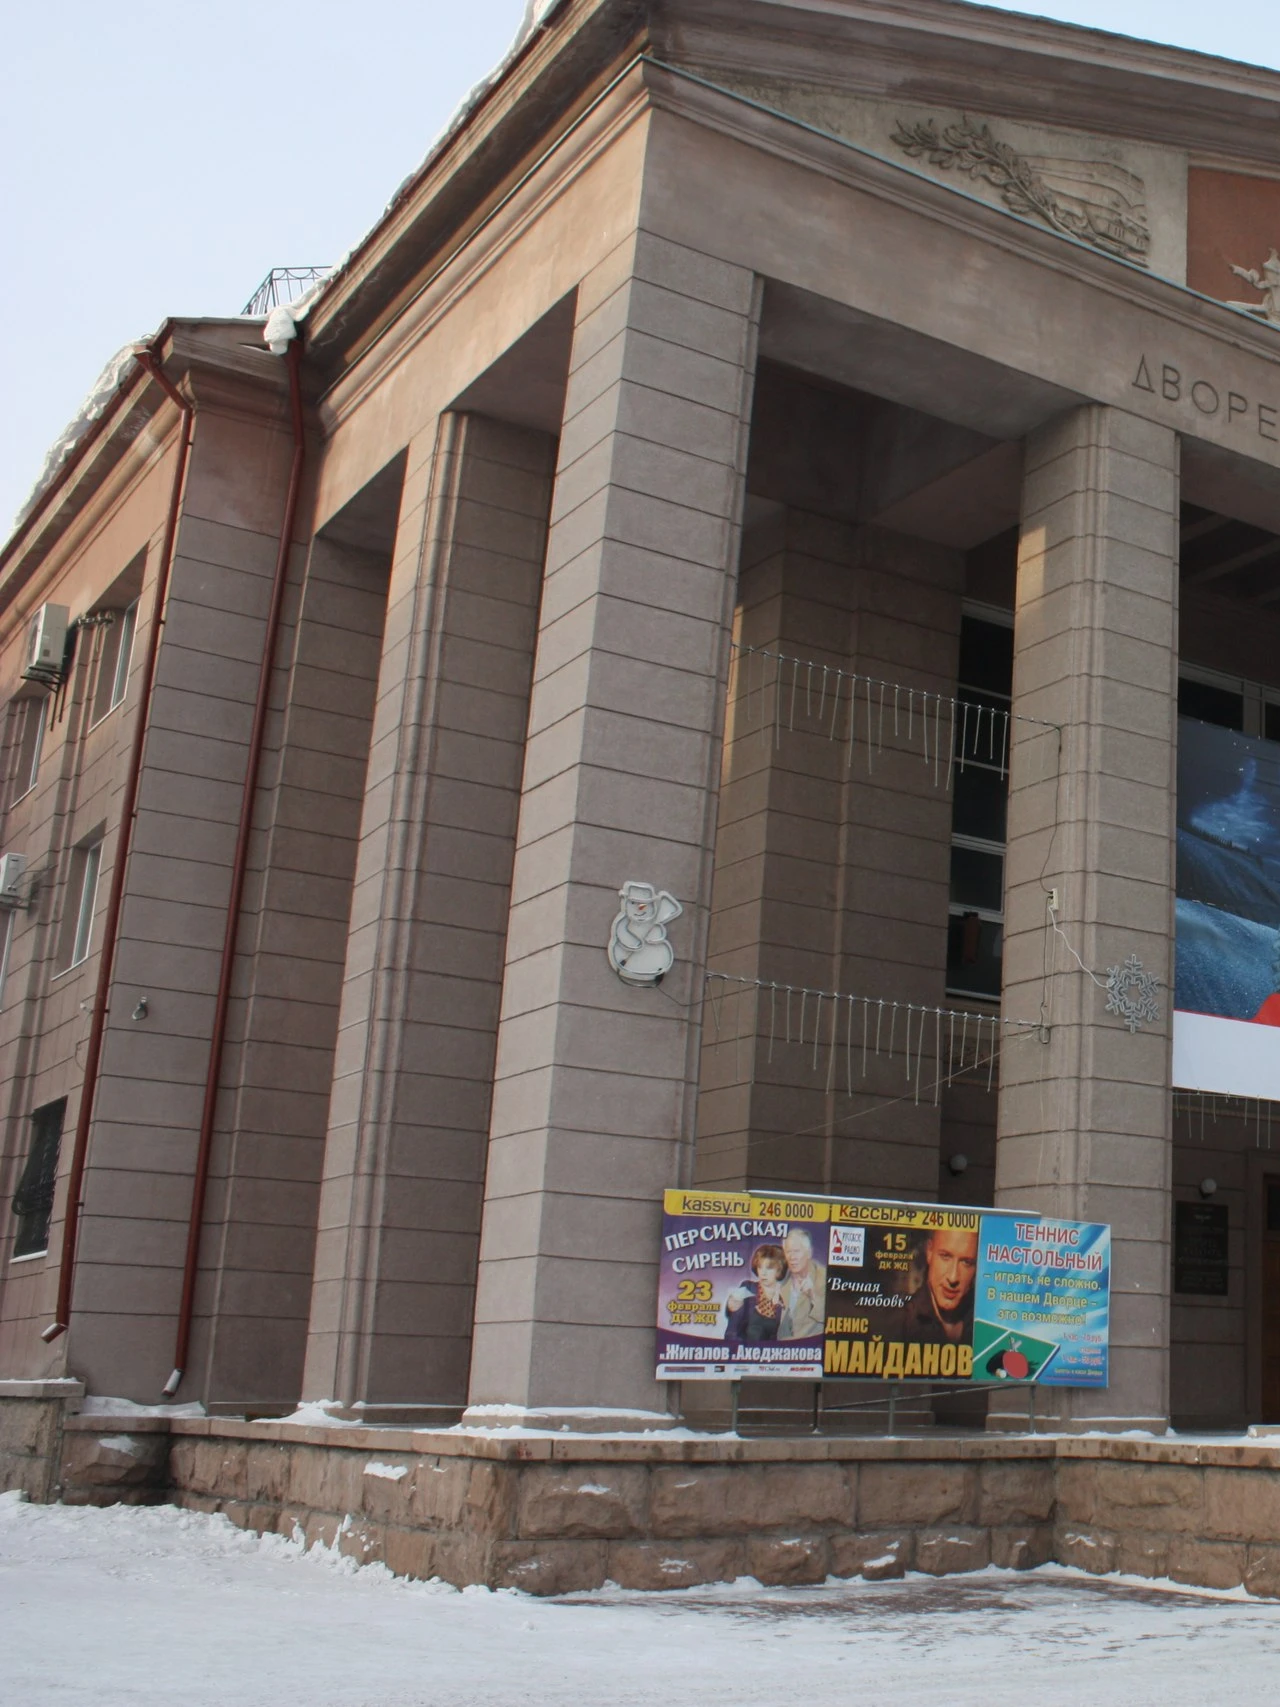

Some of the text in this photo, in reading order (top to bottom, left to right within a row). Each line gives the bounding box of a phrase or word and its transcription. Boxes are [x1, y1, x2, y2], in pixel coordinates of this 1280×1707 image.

[682, 1195, 814, 1218] kassy.ru 246 0000
[921, 1209, 944, 1227] 246
[947, 1211, 976, 1229] 0000
[664, 1221, 789, 1251] ПЕРСИДСКАЯ
[883, 1233, 907, 1251] 15
[1014, 1222, 1080, 1246] ТЕННИС
[672, 1251, 745, 1274] СИРЕНЬ
[879, 1261, 909, 1271] ДК ЖД
[987, 1243, 1103, 1272] НАСТОЛЬНЫЙ
[677, 1279, 712, 1301] 23
[994, 1271, 1034, 1285] играть
[1037, 1276, 1051, 1286] не
[1054, 1277, 1102, 1291] сложно.
[987, 1287, 996, 1300] В
[1000, 1290, 1040, 1304] нашем
[1043, 1292, 1088, 1308] Дворце
[671, 1312, 717, 1326] ДК ЖД
[998, 1308, 1018, 1320] это
[825, 1316, 869, 1334] ДЕНИС
[824, 1334, 973, 1380] МАЙДАНОВ
